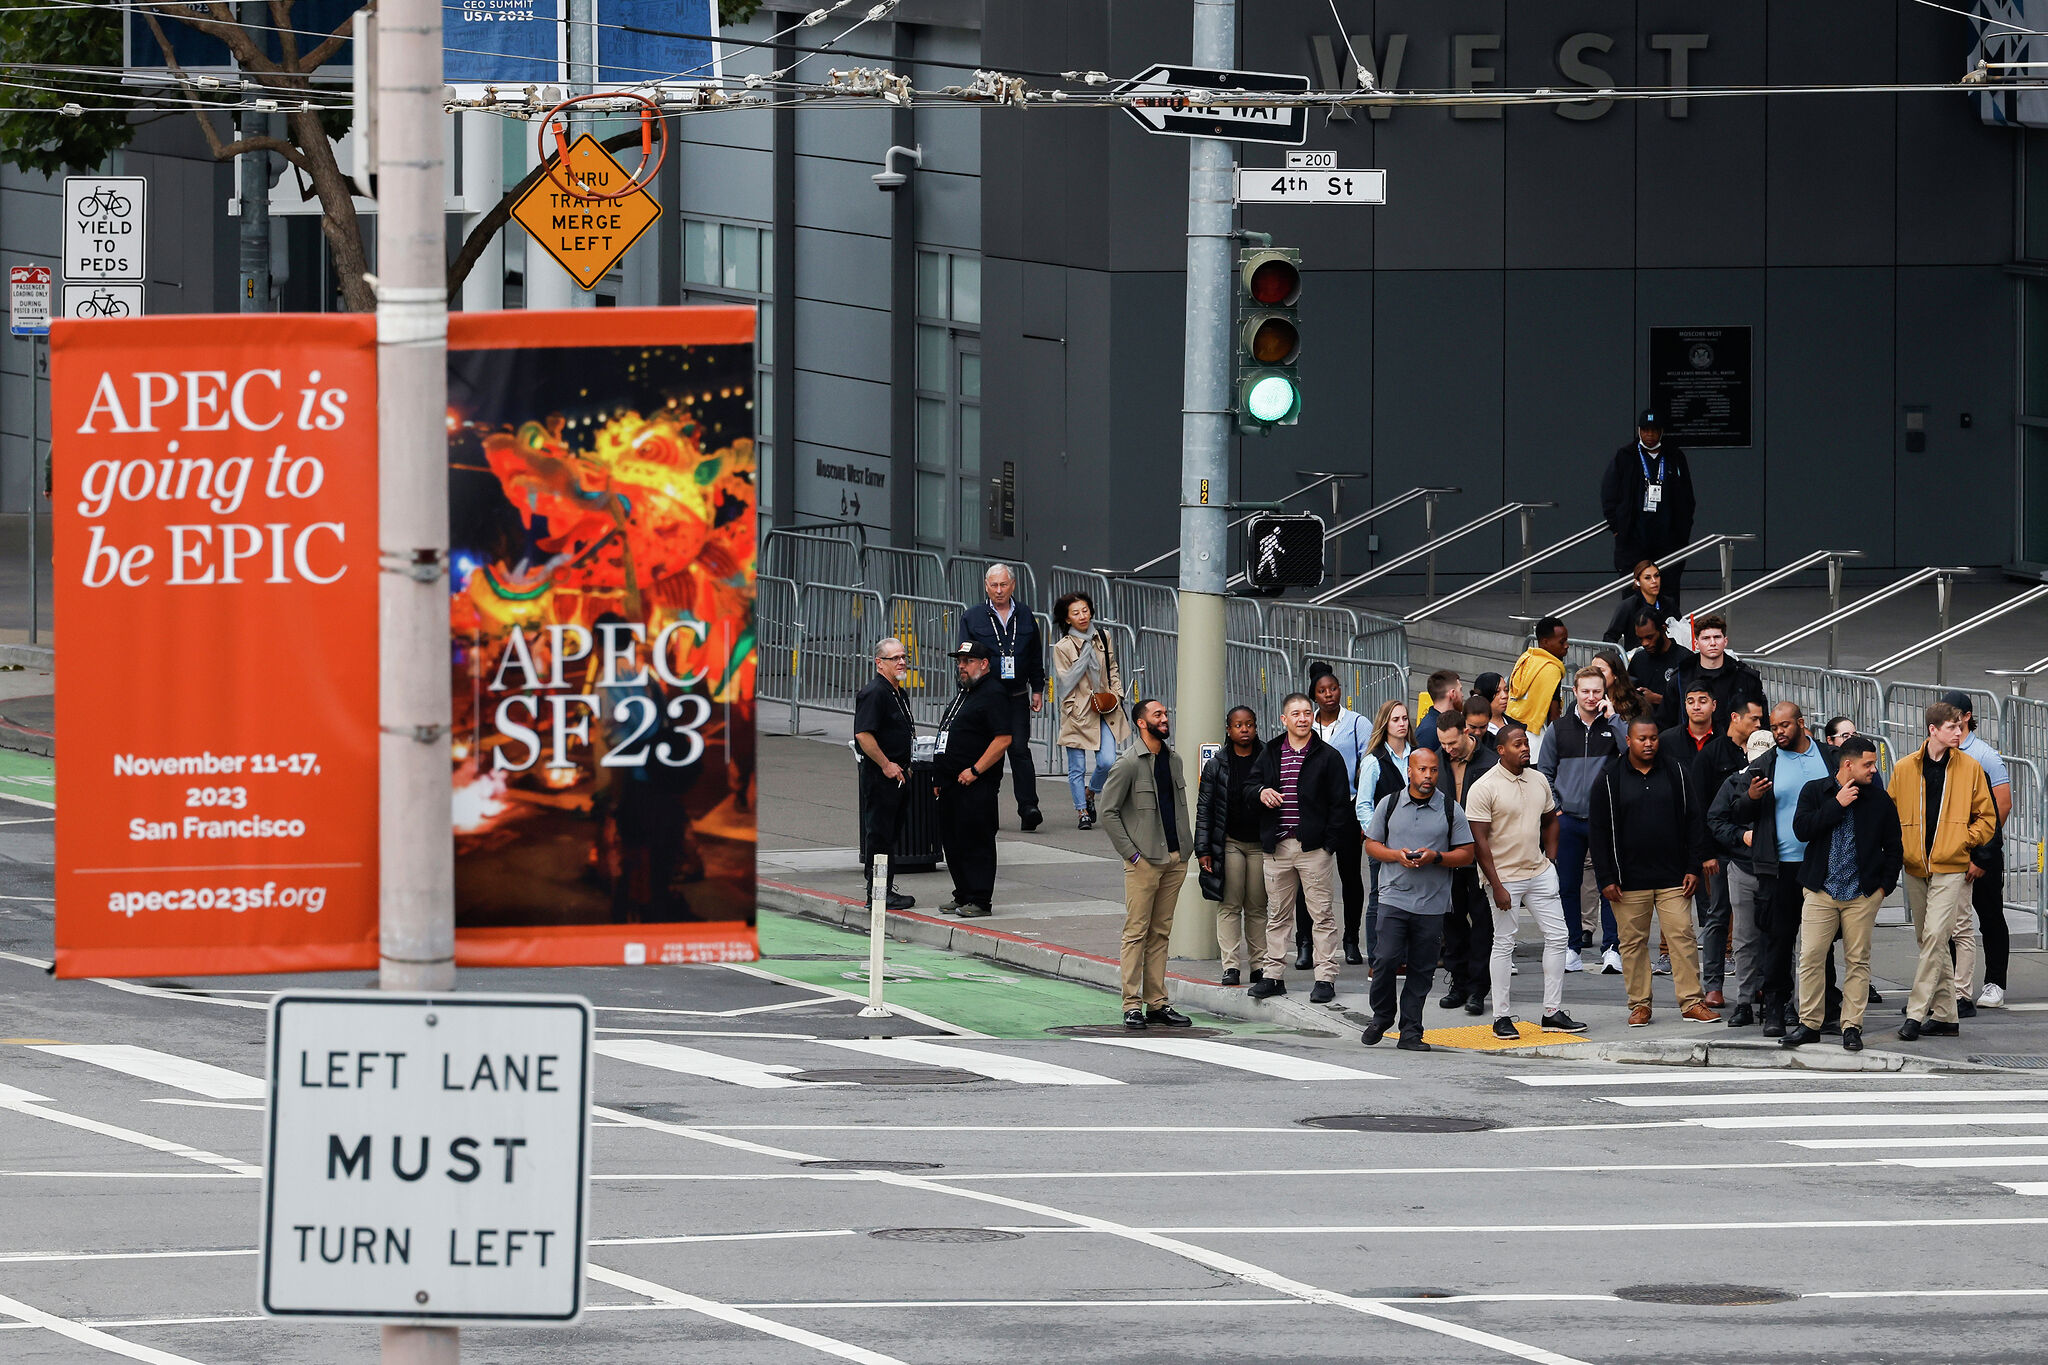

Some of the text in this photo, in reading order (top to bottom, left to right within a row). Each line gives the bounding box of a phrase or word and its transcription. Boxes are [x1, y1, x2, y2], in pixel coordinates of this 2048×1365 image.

[463, 0, 534, 9] CEO SUMMIT
[463, 10, 534, 22] USA 2023
[1312, 31, 1710, 122] WEST
[1305, 154, 1332, 166] 200
[564, 172, 609, 187] THRU
[1270, 176, 1353, 196] 4th St
[78, 221, 132, 235] YIELD
[552, 215, 621, 230] MERGE
[93, 240, 116, 253] TO
[561, 236, 613, 251] LEFT
[80, 258, 129, 272] PEDS
[76, 369, 348, 434] APEC is
[77, 440, 325, 518] going to
[1201, 479, 1208, 504] 82
[81, 521, 348, 588] be EPIC
[488, 620, 710, 692] APEC
[1752, 740, 1771, 749] MASON
[113, 751, 321, 777] November 11-17,
[185, 786, 247, 810] 2023
[129, 814, 306, 841] San Francisco
[108, 881, 327, 918] apec2023sf.org
[300, 1050, 560, 1093] LEFT LANE
[327, 1133, 527, 1185] MUST
[293, 1226, 556, 1269] TURN LEFT
